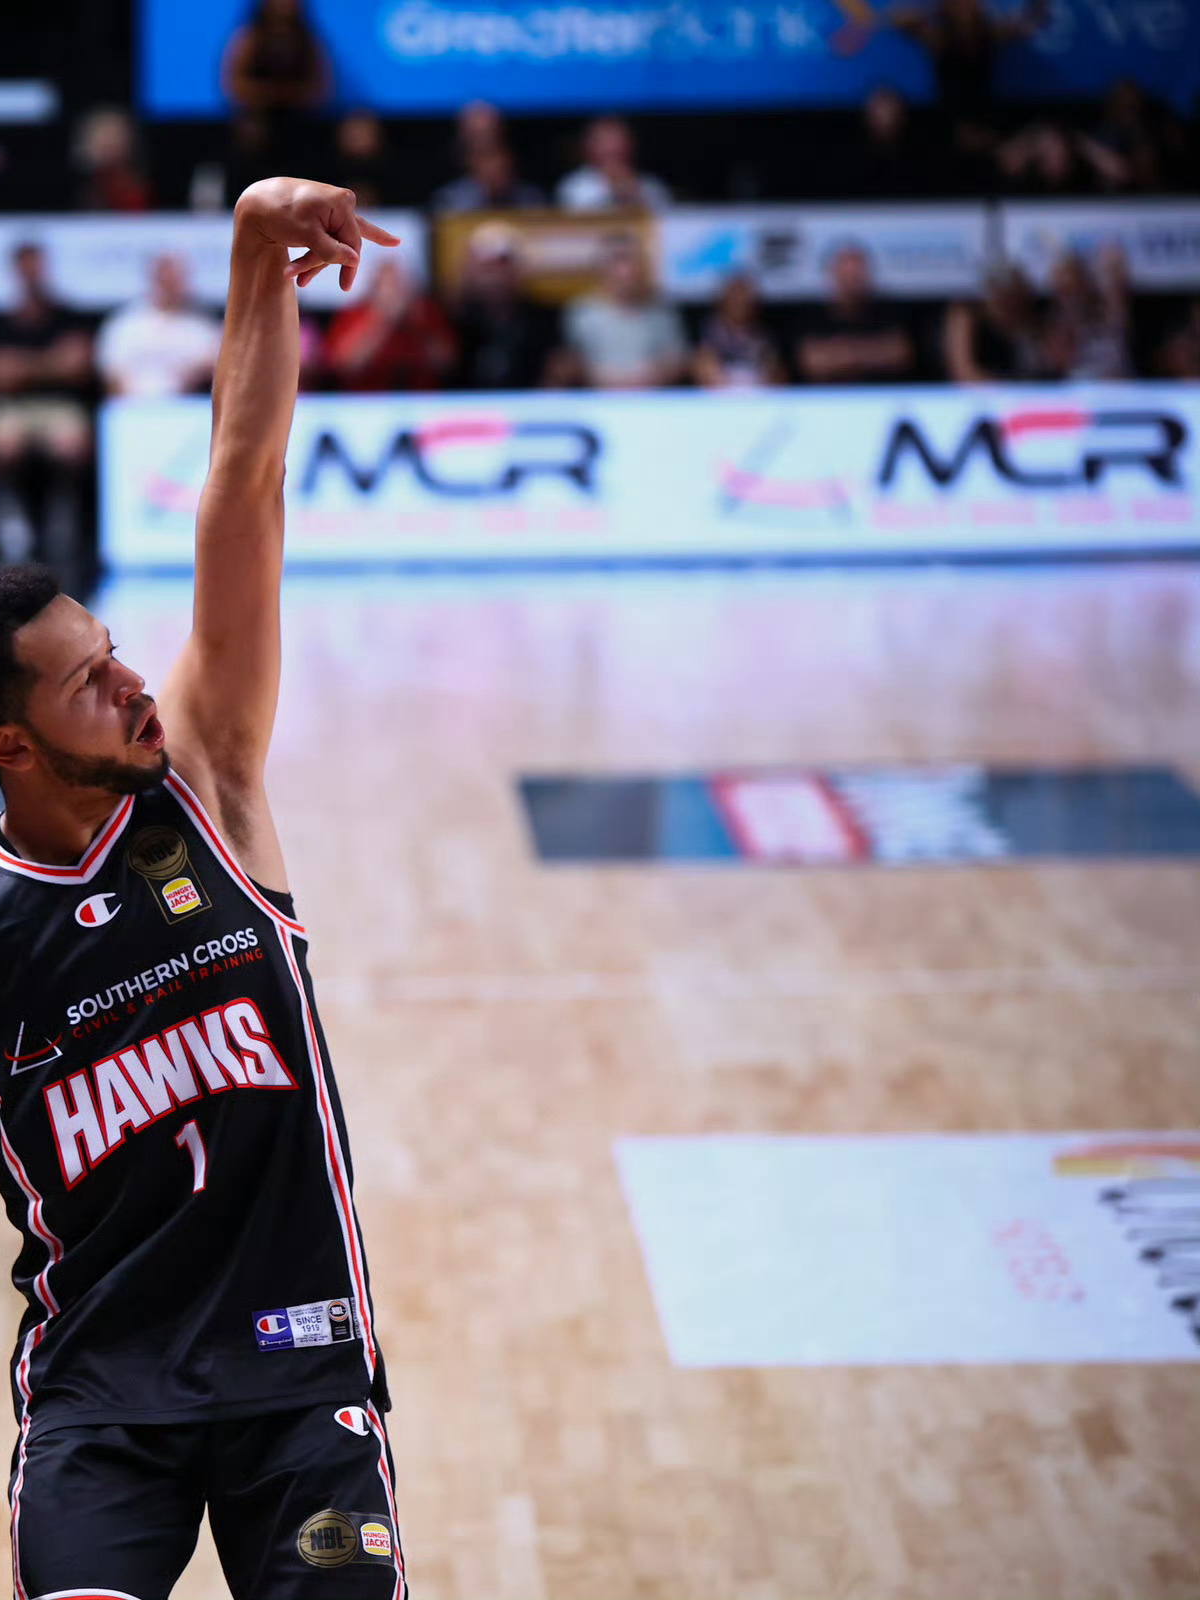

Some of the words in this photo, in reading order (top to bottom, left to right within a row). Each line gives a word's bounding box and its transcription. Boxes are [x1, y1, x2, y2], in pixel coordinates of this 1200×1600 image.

[300, 421, 602, 498] MCR
[878, 408, 1189, 490] MCR
[66, 952, 190, 1026] SOUTHERN
[192, 927, 259, 965] CROSS
[73, 1011, 120, 1039] CIVIL
[127, 1002, 137, 1014] &
[143, 980, 183, 1007] RAIL
[188, 947, 265, 983] TRAINING
[42, 996, 299, 1192] HAWKS
[174, 1118, 208, 1195] 1
[296, 1315, 323, 1326] SINCE
[302, 1324, 320, 1332] 1919
[310, 1526, 347, 1551] NBL
